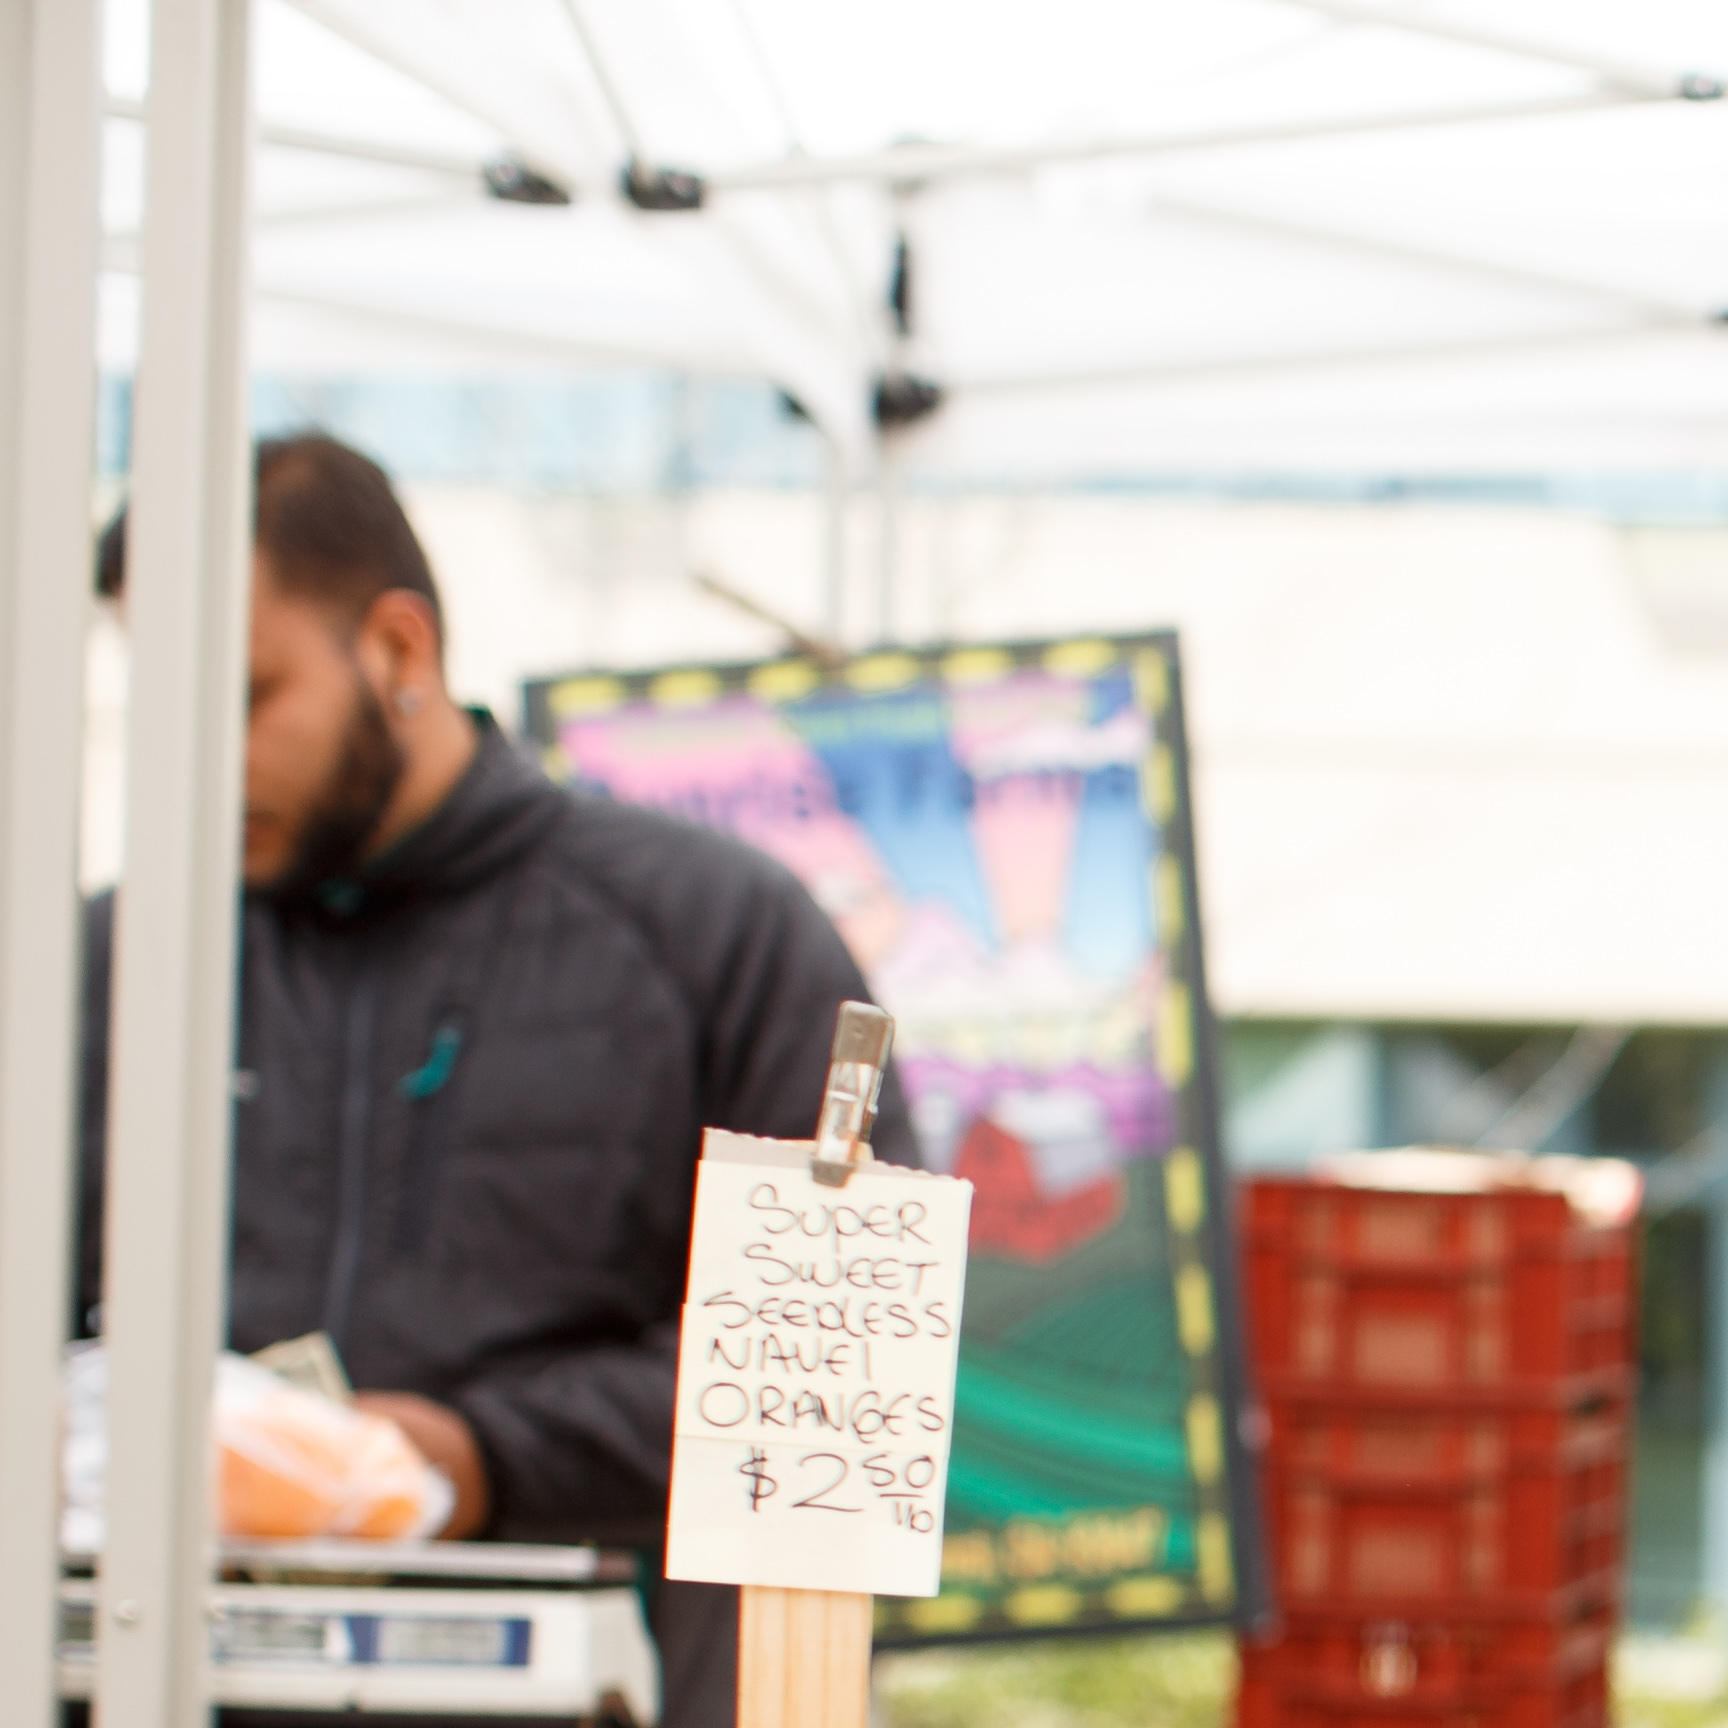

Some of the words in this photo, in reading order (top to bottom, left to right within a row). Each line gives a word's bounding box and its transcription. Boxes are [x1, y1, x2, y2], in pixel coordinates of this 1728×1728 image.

[748, 1183, 932, 1254] SUPER
[743, 1242, 942, 1297] SWEET
[702, 1291, 952, 1338] SEEDLESS
[697, 1382, 945, 1444] ORANGES
